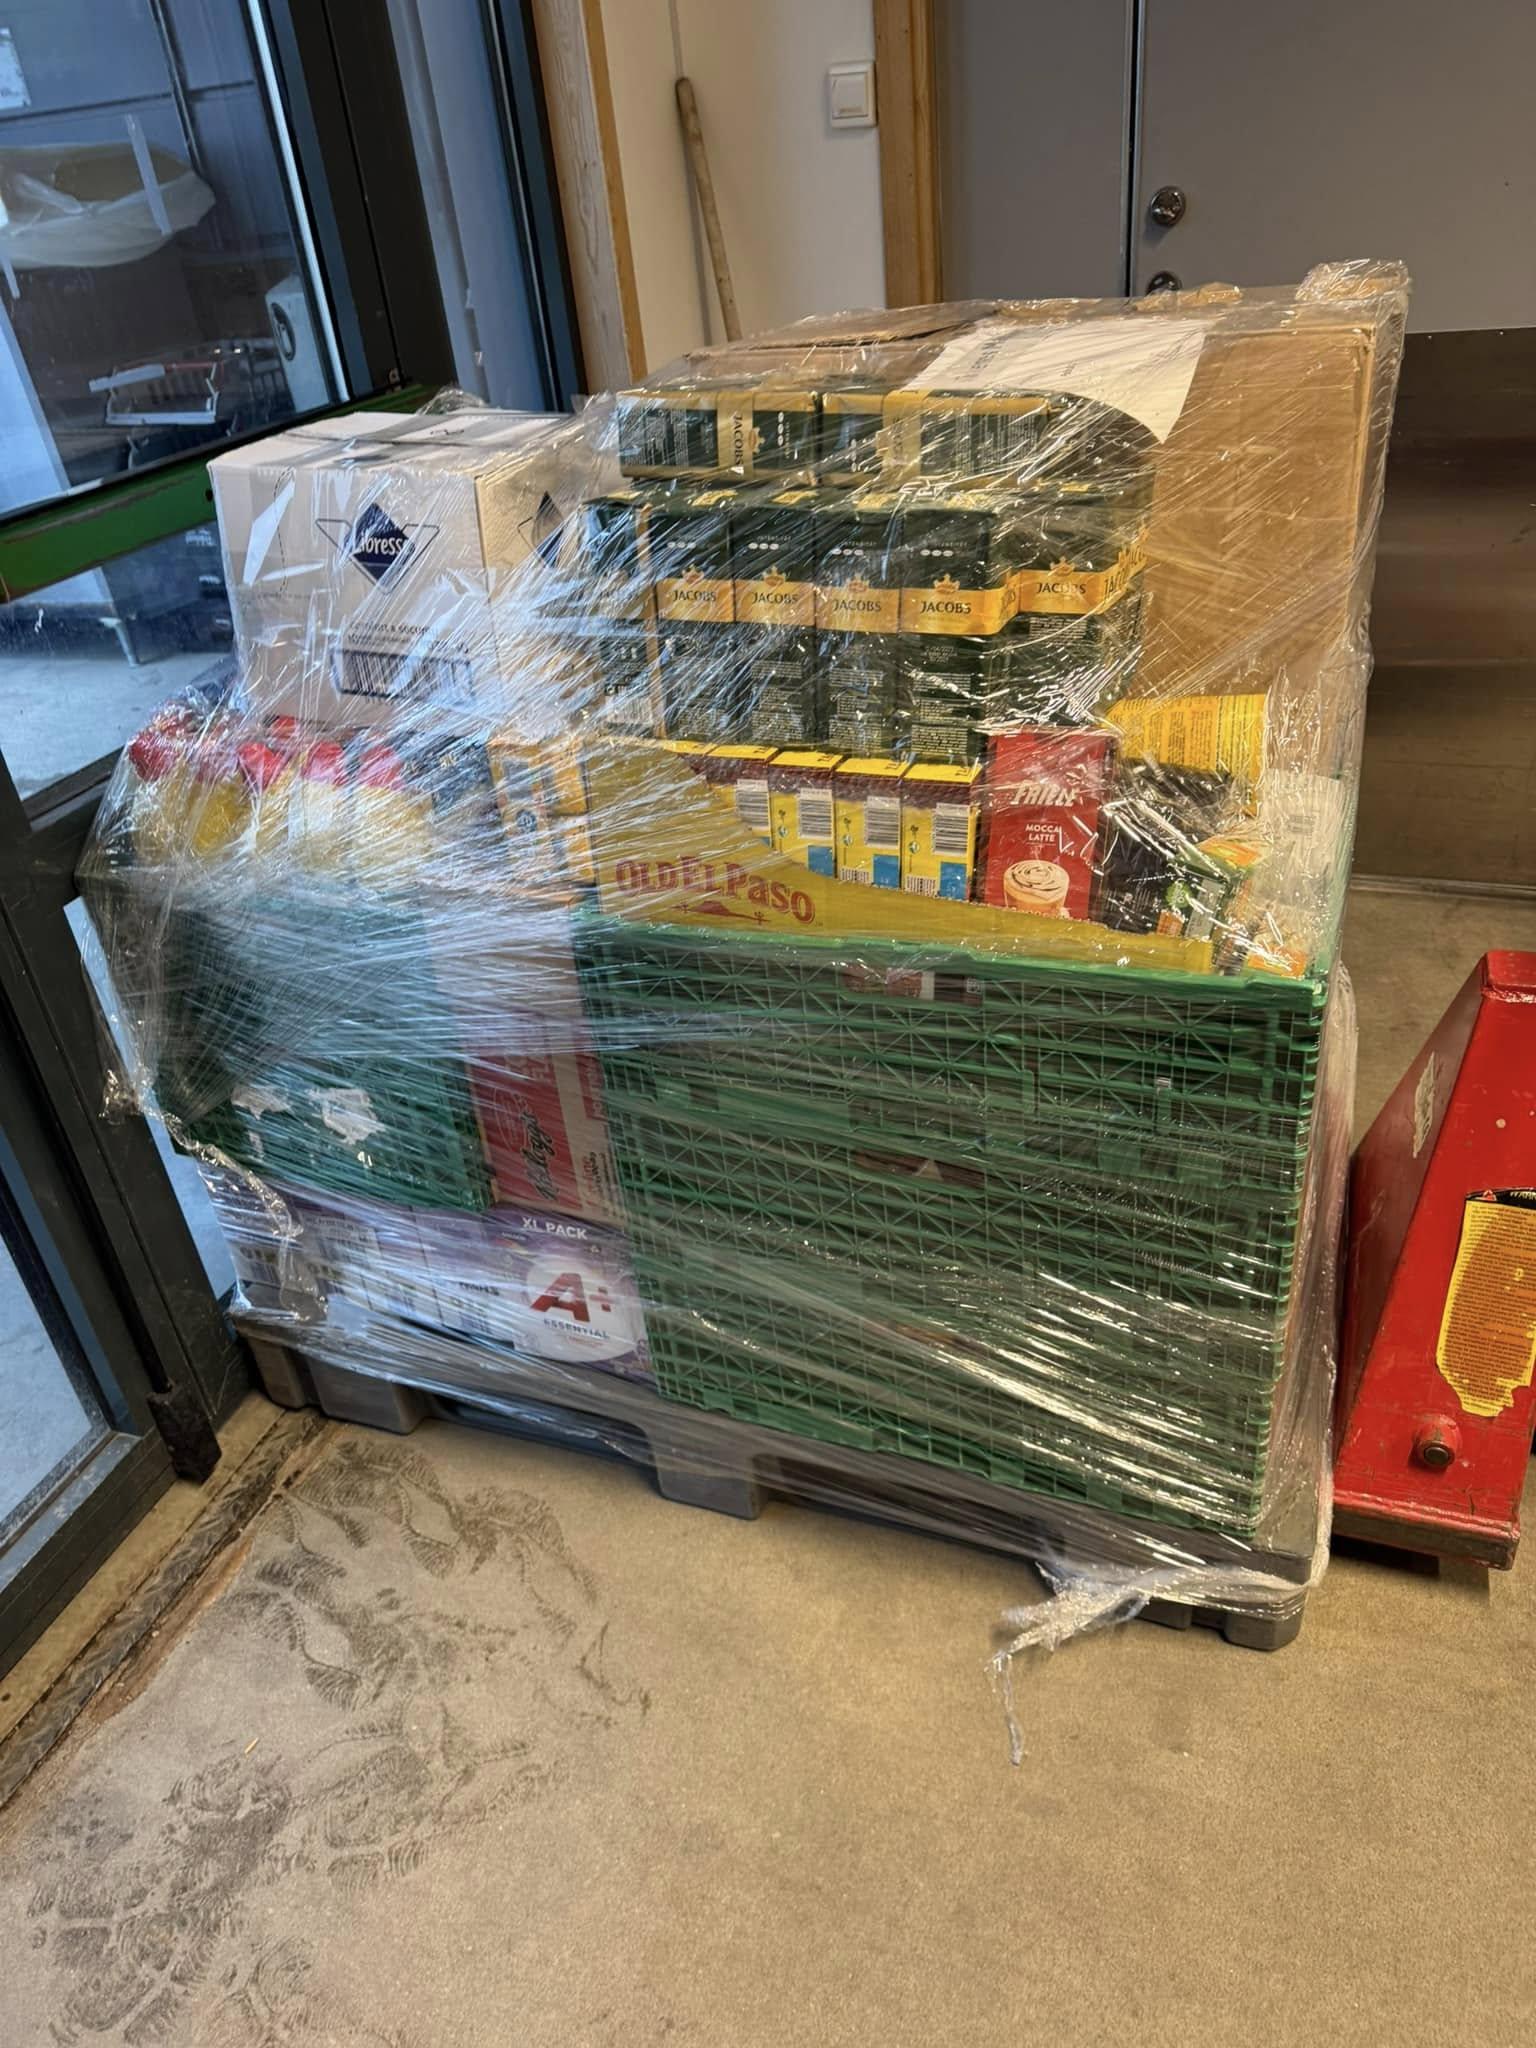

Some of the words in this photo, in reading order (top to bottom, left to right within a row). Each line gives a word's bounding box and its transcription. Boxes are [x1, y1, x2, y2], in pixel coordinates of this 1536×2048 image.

[733, 414, 744, 466] JACOBS
[673, 590, 717, 602] JACOBS
[752, 592, 798, 604] JACOBS
[832, 600, 882, 613] JACOBS
[920, 601, 972, 615] JACOBS
[1025, 823, 1060, 833] MOCCA
[1028, 832, 1056, 843] LATTE
[522, 1216, 544, 1233] XL
[545, 1221, 588, 1240] PACK
[543, 1318, 611, 1339] ESSENTIAL
